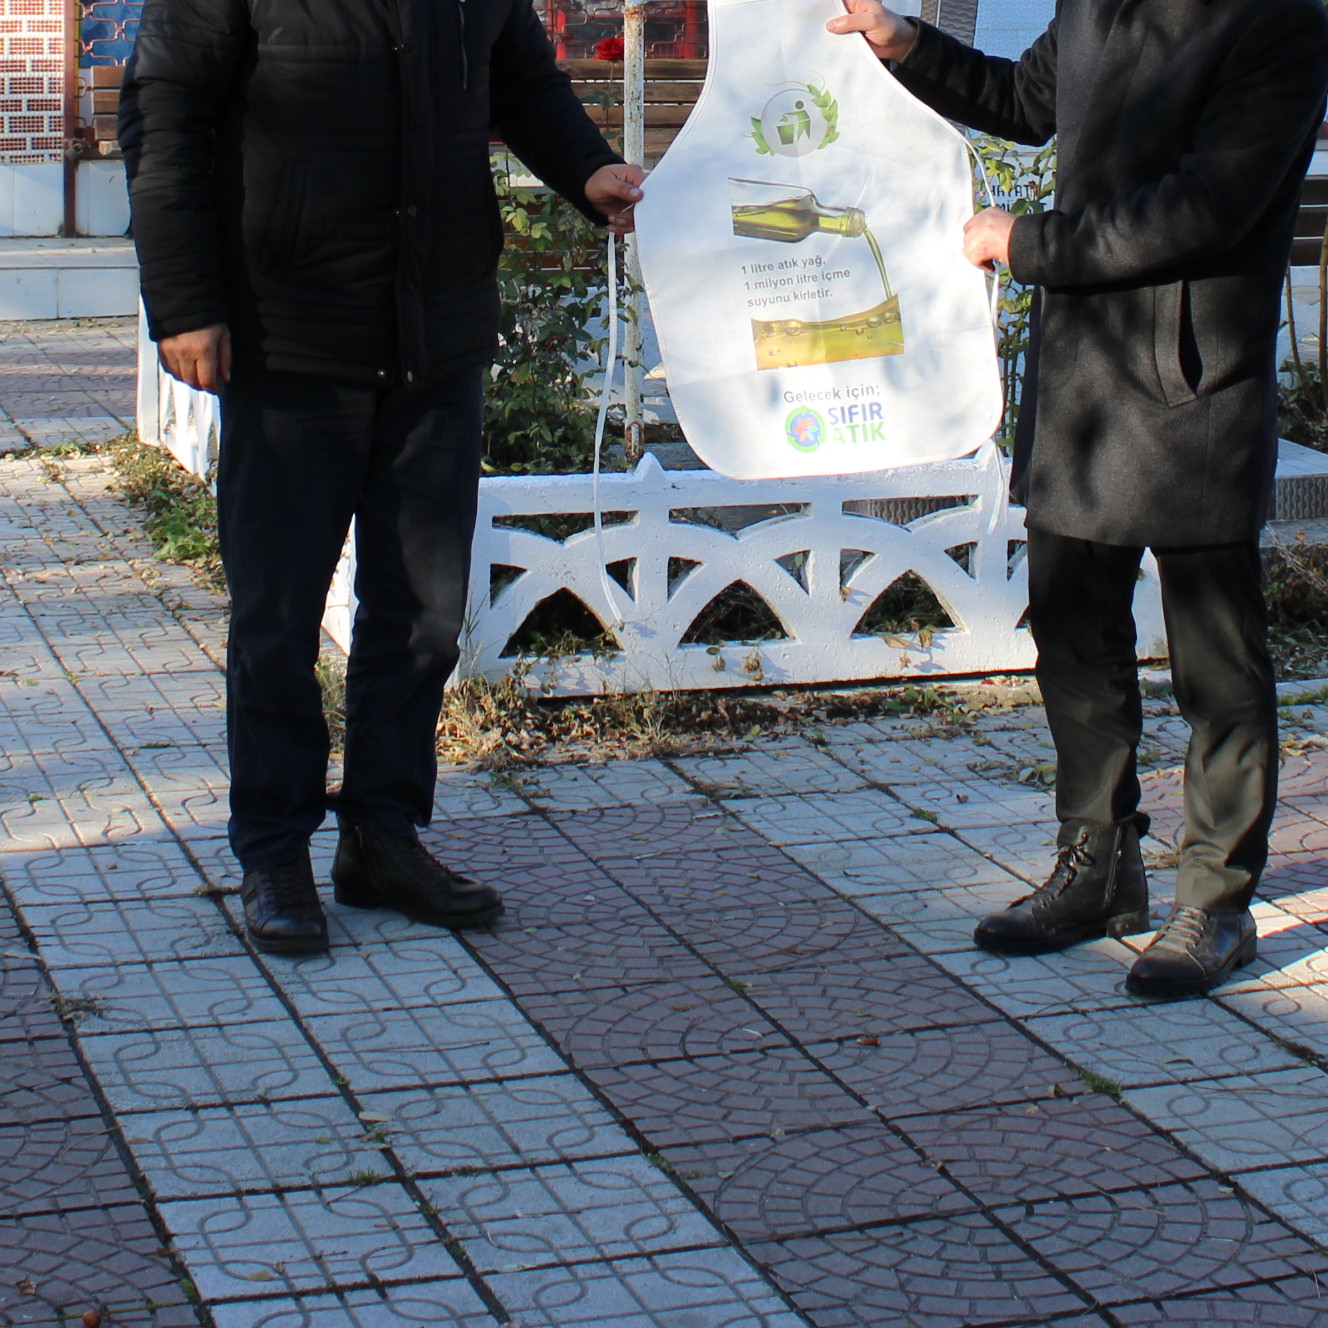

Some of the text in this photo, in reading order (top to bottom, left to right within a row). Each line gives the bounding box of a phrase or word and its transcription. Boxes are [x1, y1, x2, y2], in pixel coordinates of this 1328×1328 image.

[741, 255, 826, 275] 1 litre atık yağ,
[744, 269, 851, 291] 1 milyon litre içme
[747, 287, 833, 308] suyunu kirletir.
[783, 383, 881, 403] Gelecek için;
[828, 402, 884, 425] SIFIR
[832, 421, 888, 445] ATIK
